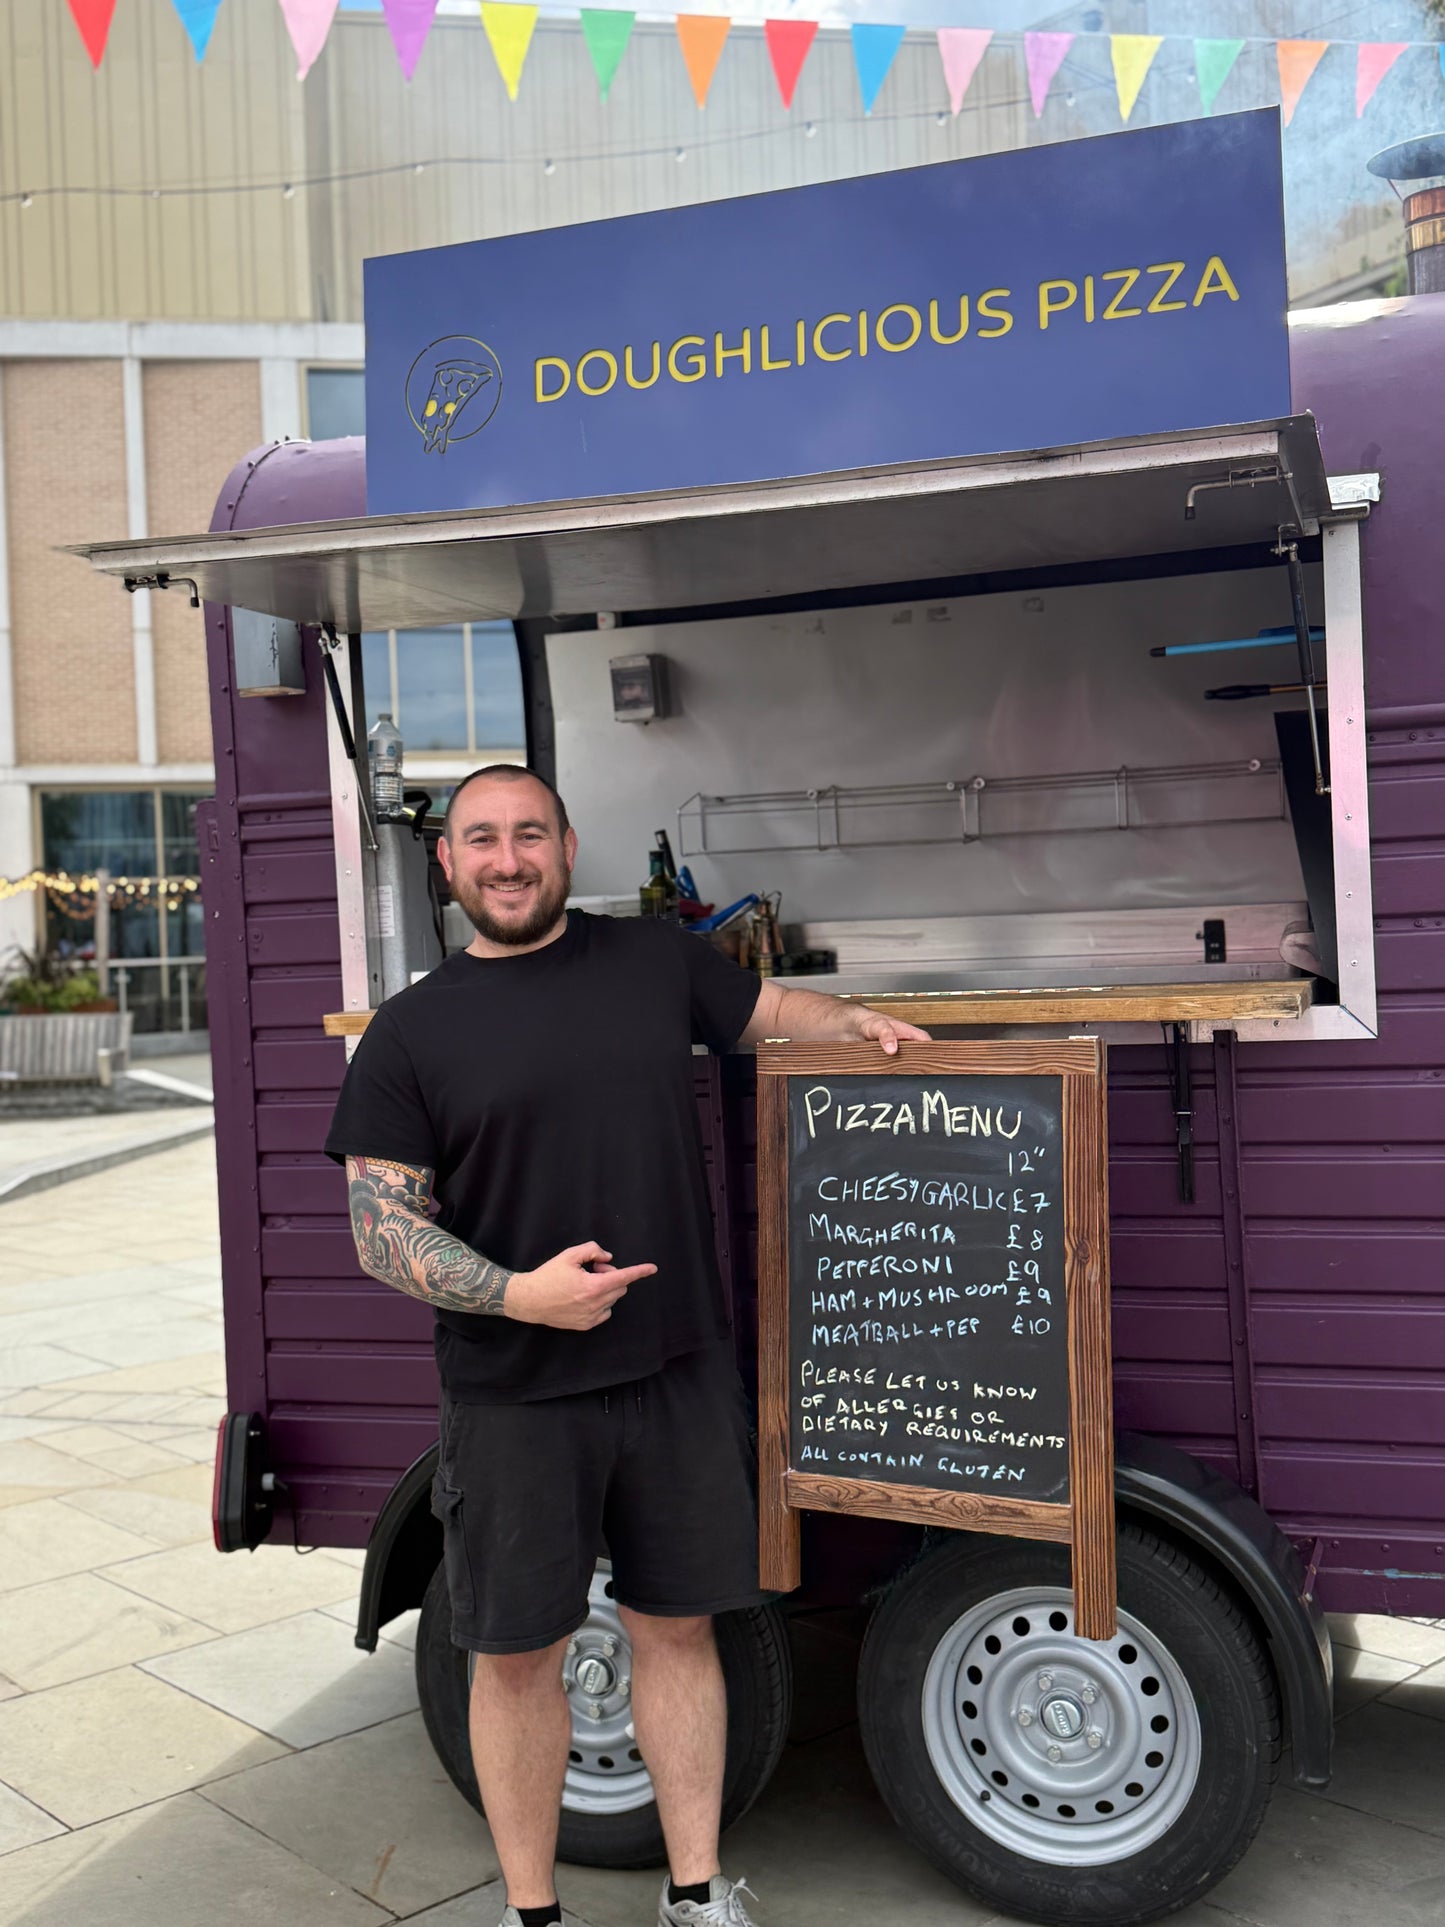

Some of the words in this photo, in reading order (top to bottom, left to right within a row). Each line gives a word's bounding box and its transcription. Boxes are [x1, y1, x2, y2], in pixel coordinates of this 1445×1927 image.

[534, 288, 1013, 404] DOUGHLICIOUS
[1037, 256, 1240, 330] PIZZA
[805, 1086, 916, 1138] PIZZA
[920, 1090, 1022, 1139] MENU
[818, 1171, 919, 1203] CHEESY
[922, 1181, 1007, 1210] GARLIC
[1013, 1188, 1051, 1214] £7
[809, 1213, 956, 1248] MARGHERITA
[1006, 1224, 1044, 1251] £8
[817, 1255, 953, 1280] PEPPERONI
[1006, 1259, 1041, 1284] £9
[811, 1289, 856, 1314] HAM
[879, 1284, 1008, 1310] MUSHROOM
[1016, 1286, 1051, 1306] £9
[811, 1319, 924, 1346] MEATBALL
[946, 1317, 980, 1338] PEP
[1011, 1315, 1050, 1335] £10
[801, 1360, 877, 1387] PLEASE
[886, 1372, 926, 1390] LET
[936, 1379, 960, 1392] US
[973, 1383, 1037, 1400] KNOW
[801, 1394, 826, 1408] OF
[971, 1411, 1004, 1425] OR
[802, 1416, 888, 1436] DIETARY
[906, 1422, 1065, 1448] REQUIREMENTS
[800, 1446, 829, 1461] ALL
[838, 1451, 924, 1467] CONTAIN
[937, 1457, 1025, 1481] GLUTEN
